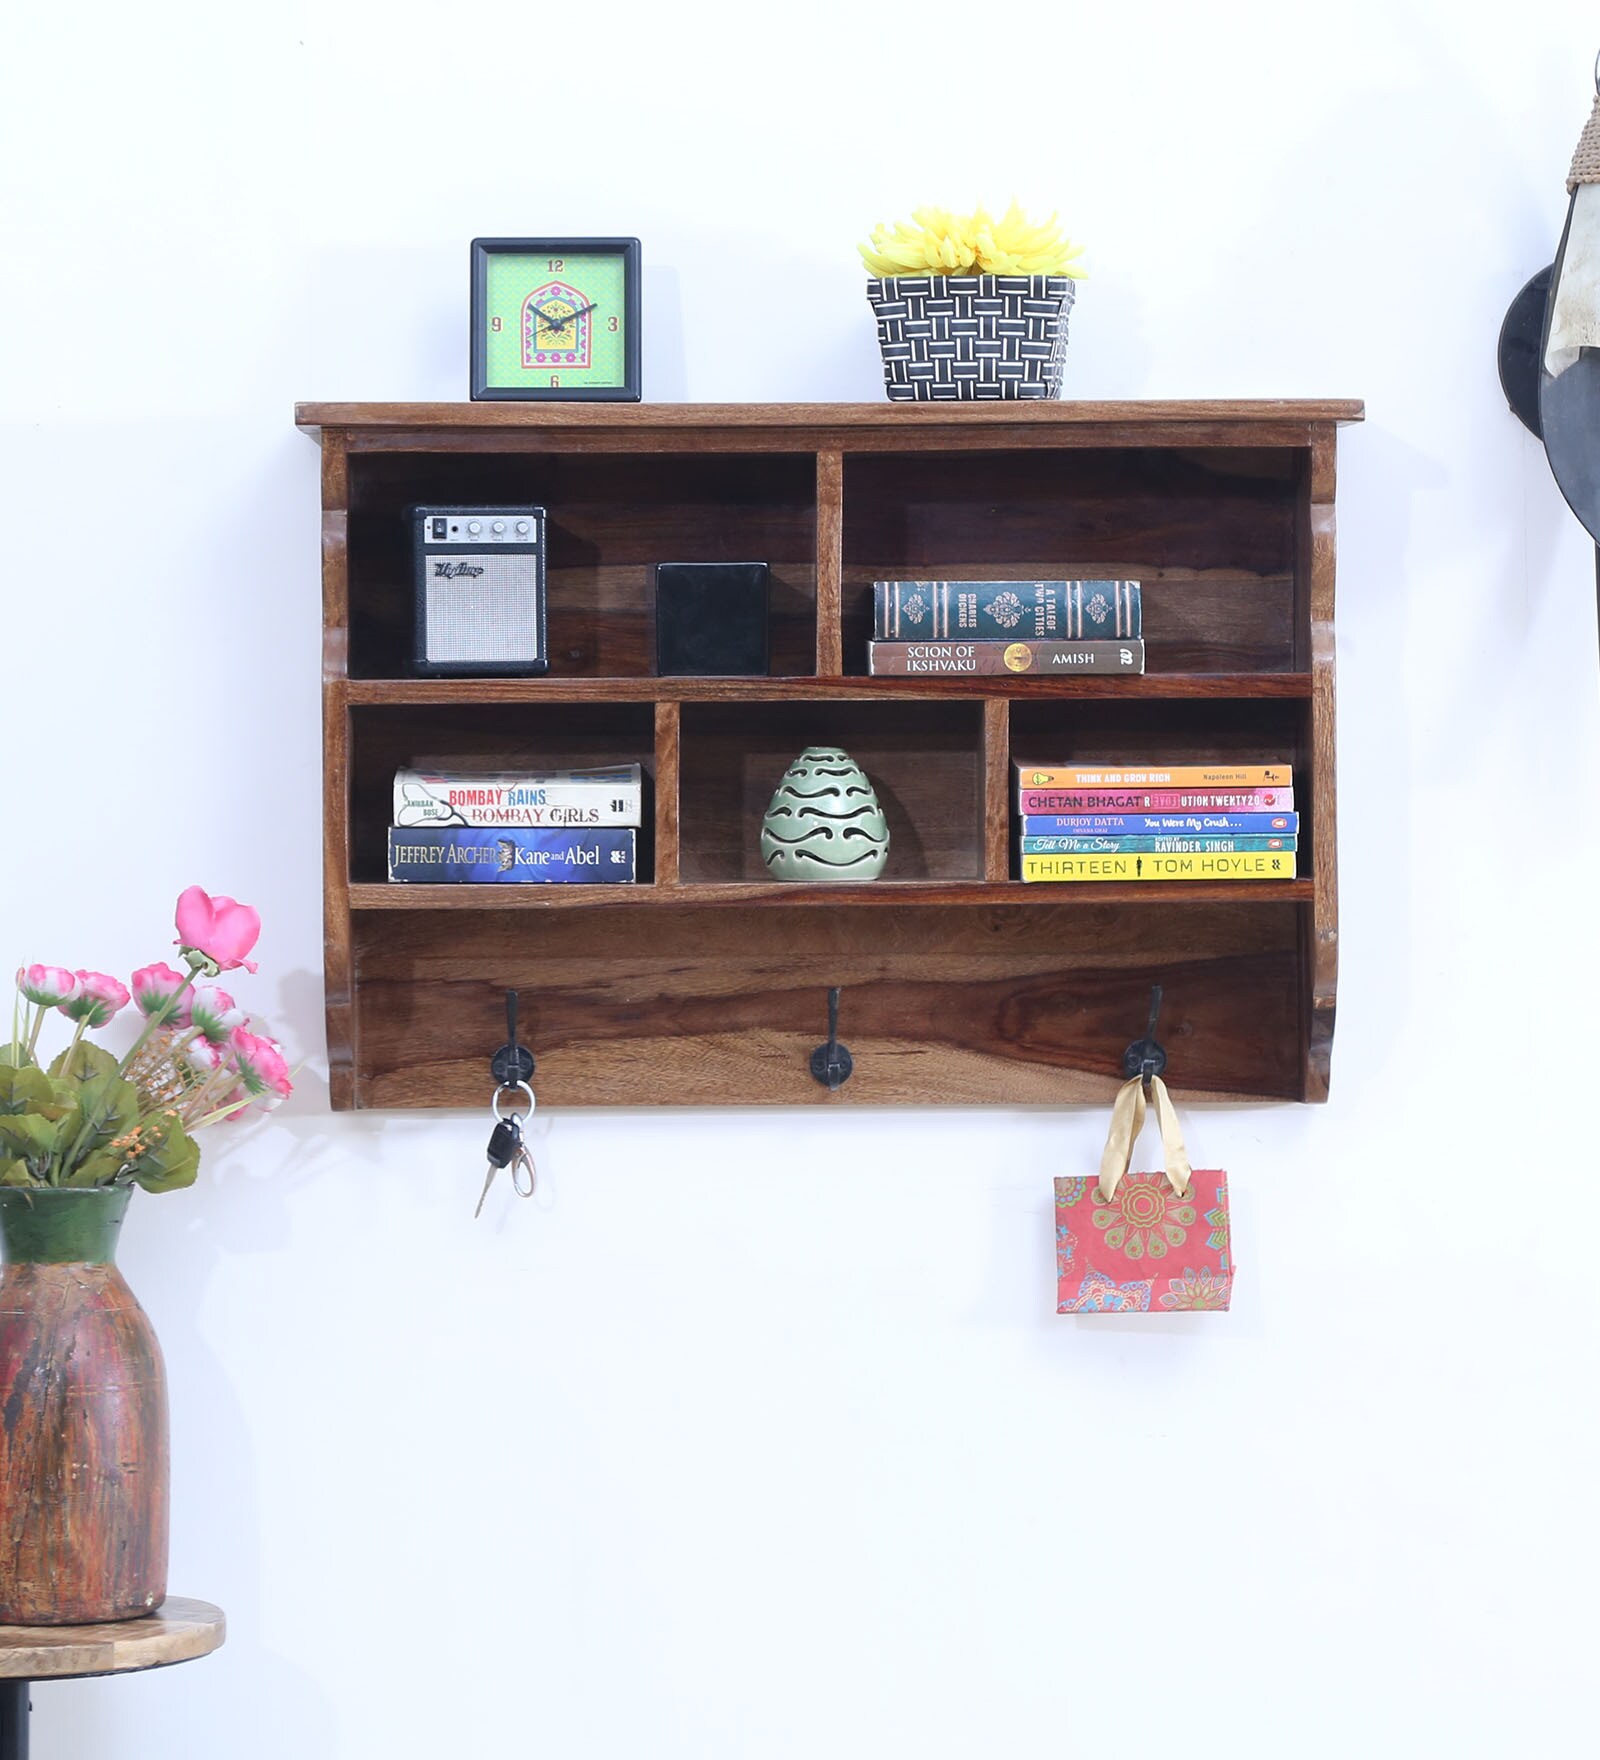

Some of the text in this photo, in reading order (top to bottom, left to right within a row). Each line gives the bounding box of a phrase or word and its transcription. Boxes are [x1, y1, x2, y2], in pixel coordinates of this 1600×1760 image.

[547, 259, 564, 273] 12
[491, 316, 502, 332] 9
[607, 316, 618, 332] 3
[550, 375, 560, 388] 6
[958, 593, 967, 629] DICKENS
[967, 593, 977, 629] CHARLES
[1034, 583, 1045, 637] TWO CITIES
[907, 646, 976, 659] SCION OF
[1052, 653, 1095, 665] AMISH
[906, 659, 977, 672] IKSHVAKU
[1075, 773, 1171, 783] THINK AND GROW RICH
[1203, 773, 1234, 781] Napoleon
[449, 788, 546, 807] BOMBAY RAINS
[1028, 796, 1142, 808] CHETAN BHAGAT
[422, 808, 439, 817] BOSE
[472, 808, 600, 824] BOMBAY GIRLS
[1056, 817, 1125, 827] DURJOY DATTA
[1144, 817, 1160, 828] You
[1162, 816, 1185, 828] Were
[1186, 817, 1202, 831] My
[1033, 839, 1056, 852] Tell
[1058, 838, 1081, 851] Me
[1090, 837, 1120, 853] Story
[1155, 841, 1235, 852] RAVINDER SINGH
[393, 843, 498, 868] JEFFREY ARCHER
[514, 845, 600, 865] Kane and Abel
[1028, 861, 1127, 875] THIRTEEN
[1152, 858, 1265, 873] TOM HOYLE
